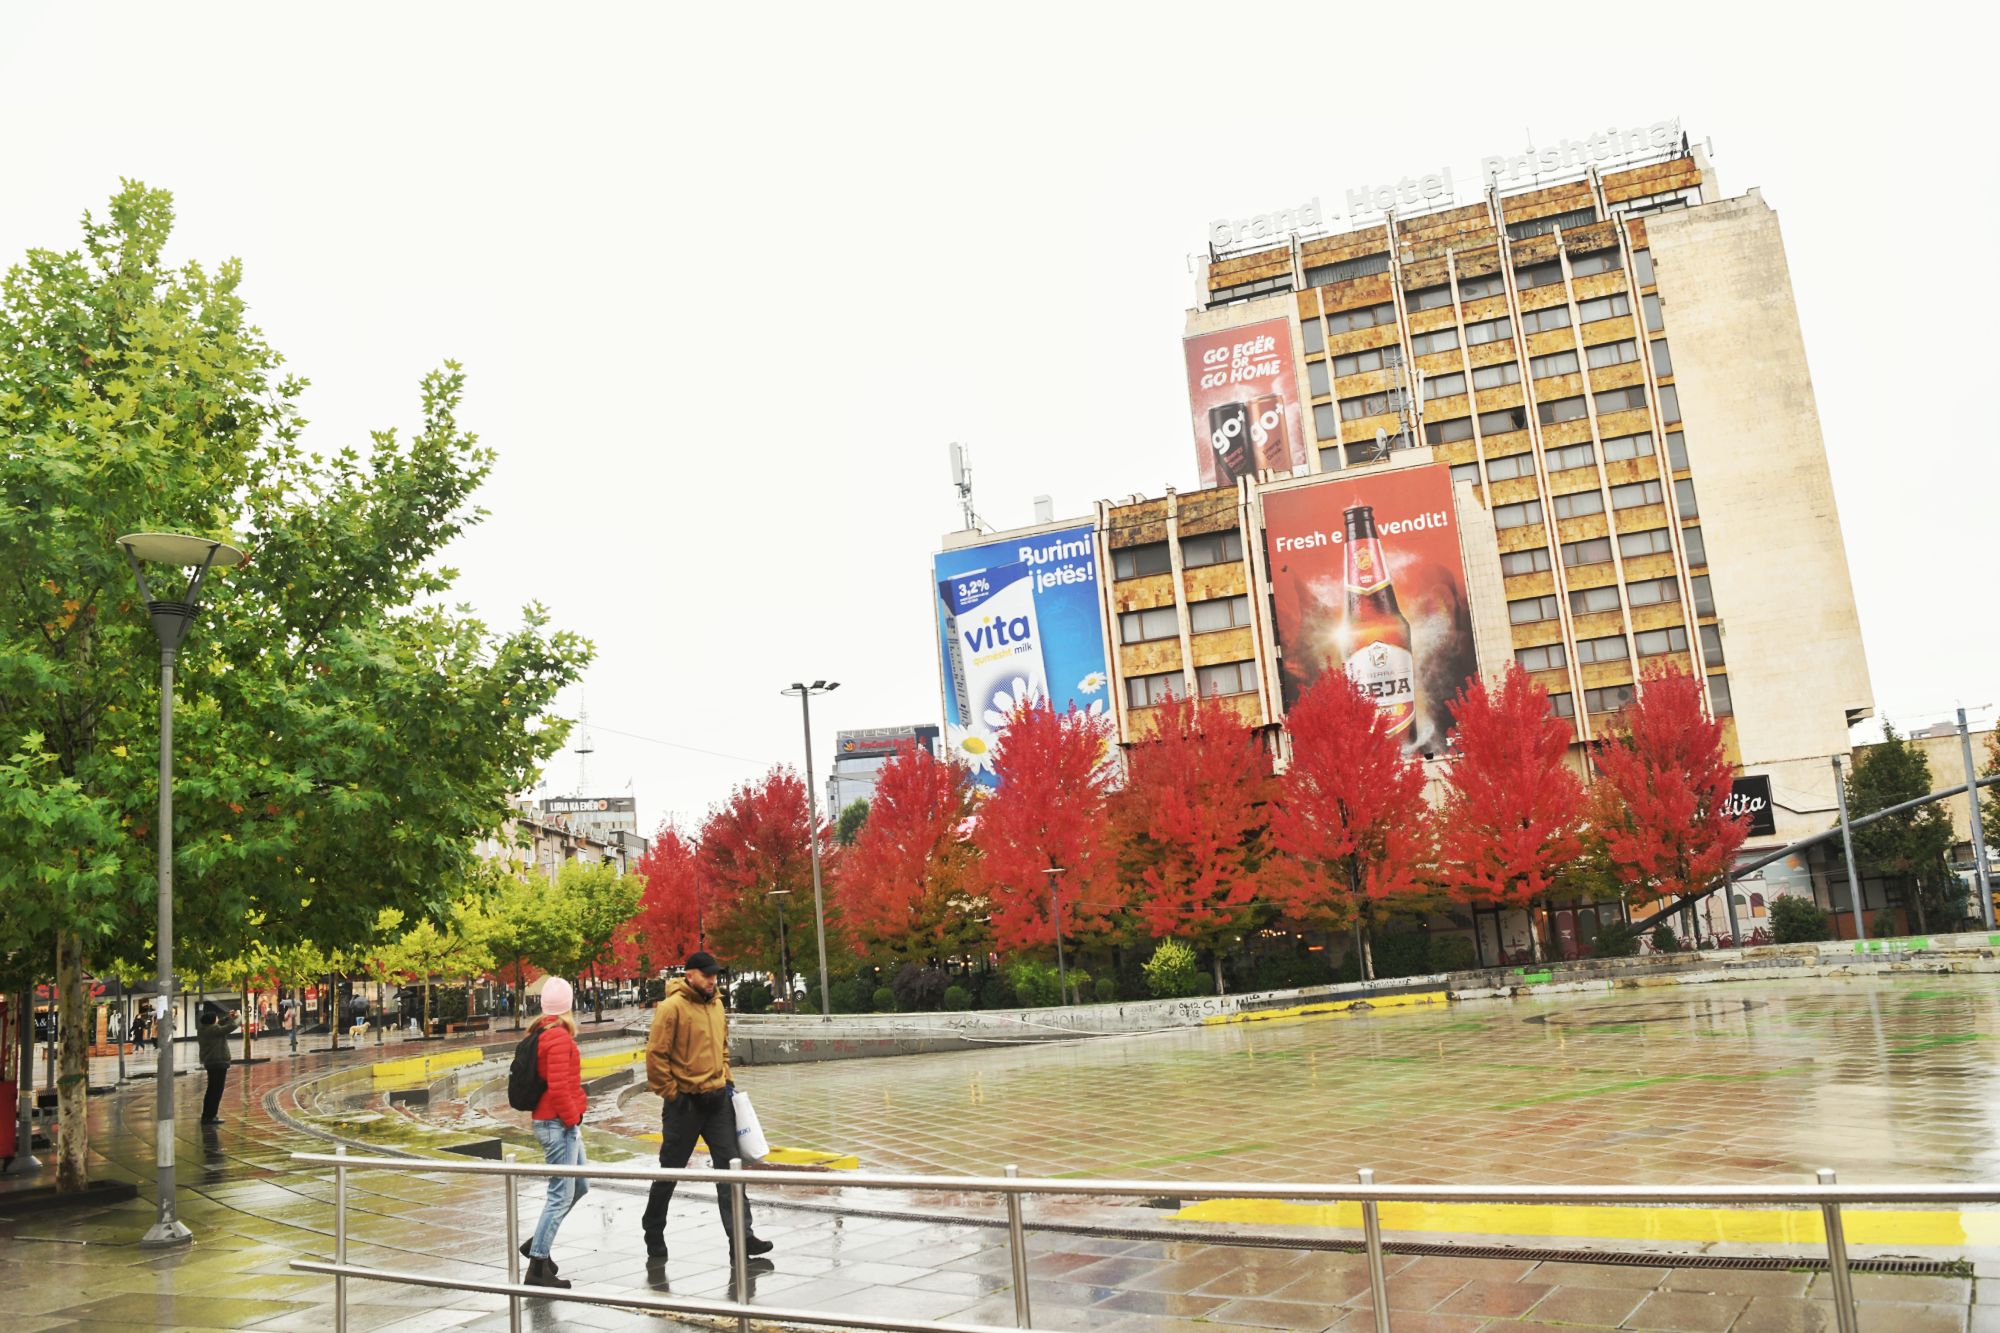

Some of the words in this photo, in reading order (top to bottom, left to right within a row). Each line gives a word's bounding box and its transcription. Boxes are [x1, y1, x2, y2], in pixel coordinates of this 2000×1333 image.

[1210, 197, 1323, 247] Grand
[1346, 166, 1454, 217] Hotel
[1481, 119, 1677, 184] Prishtina
[1203, 347, 1229, 364] GO
[1232, 335, 1275, 359] EGËR
[1231, 356, 1249, 369] OR
[1200, 371, 1227, 389] GO
[1230, 360, 1281, 384] HOME
[1276, 531, 1327, 552] Fresh
[1331, 530, 1343, 543] e
[1378, 511, 1448, 536] vendit!
[1019, 533, 1091, 566] Burimi
[958, 578, 990, 597] 3,2%
[1036, 561, 1094, 594] jetës!
[964, 615, 1031, 653] vita
[1014, 642, 1033, 654] milk
